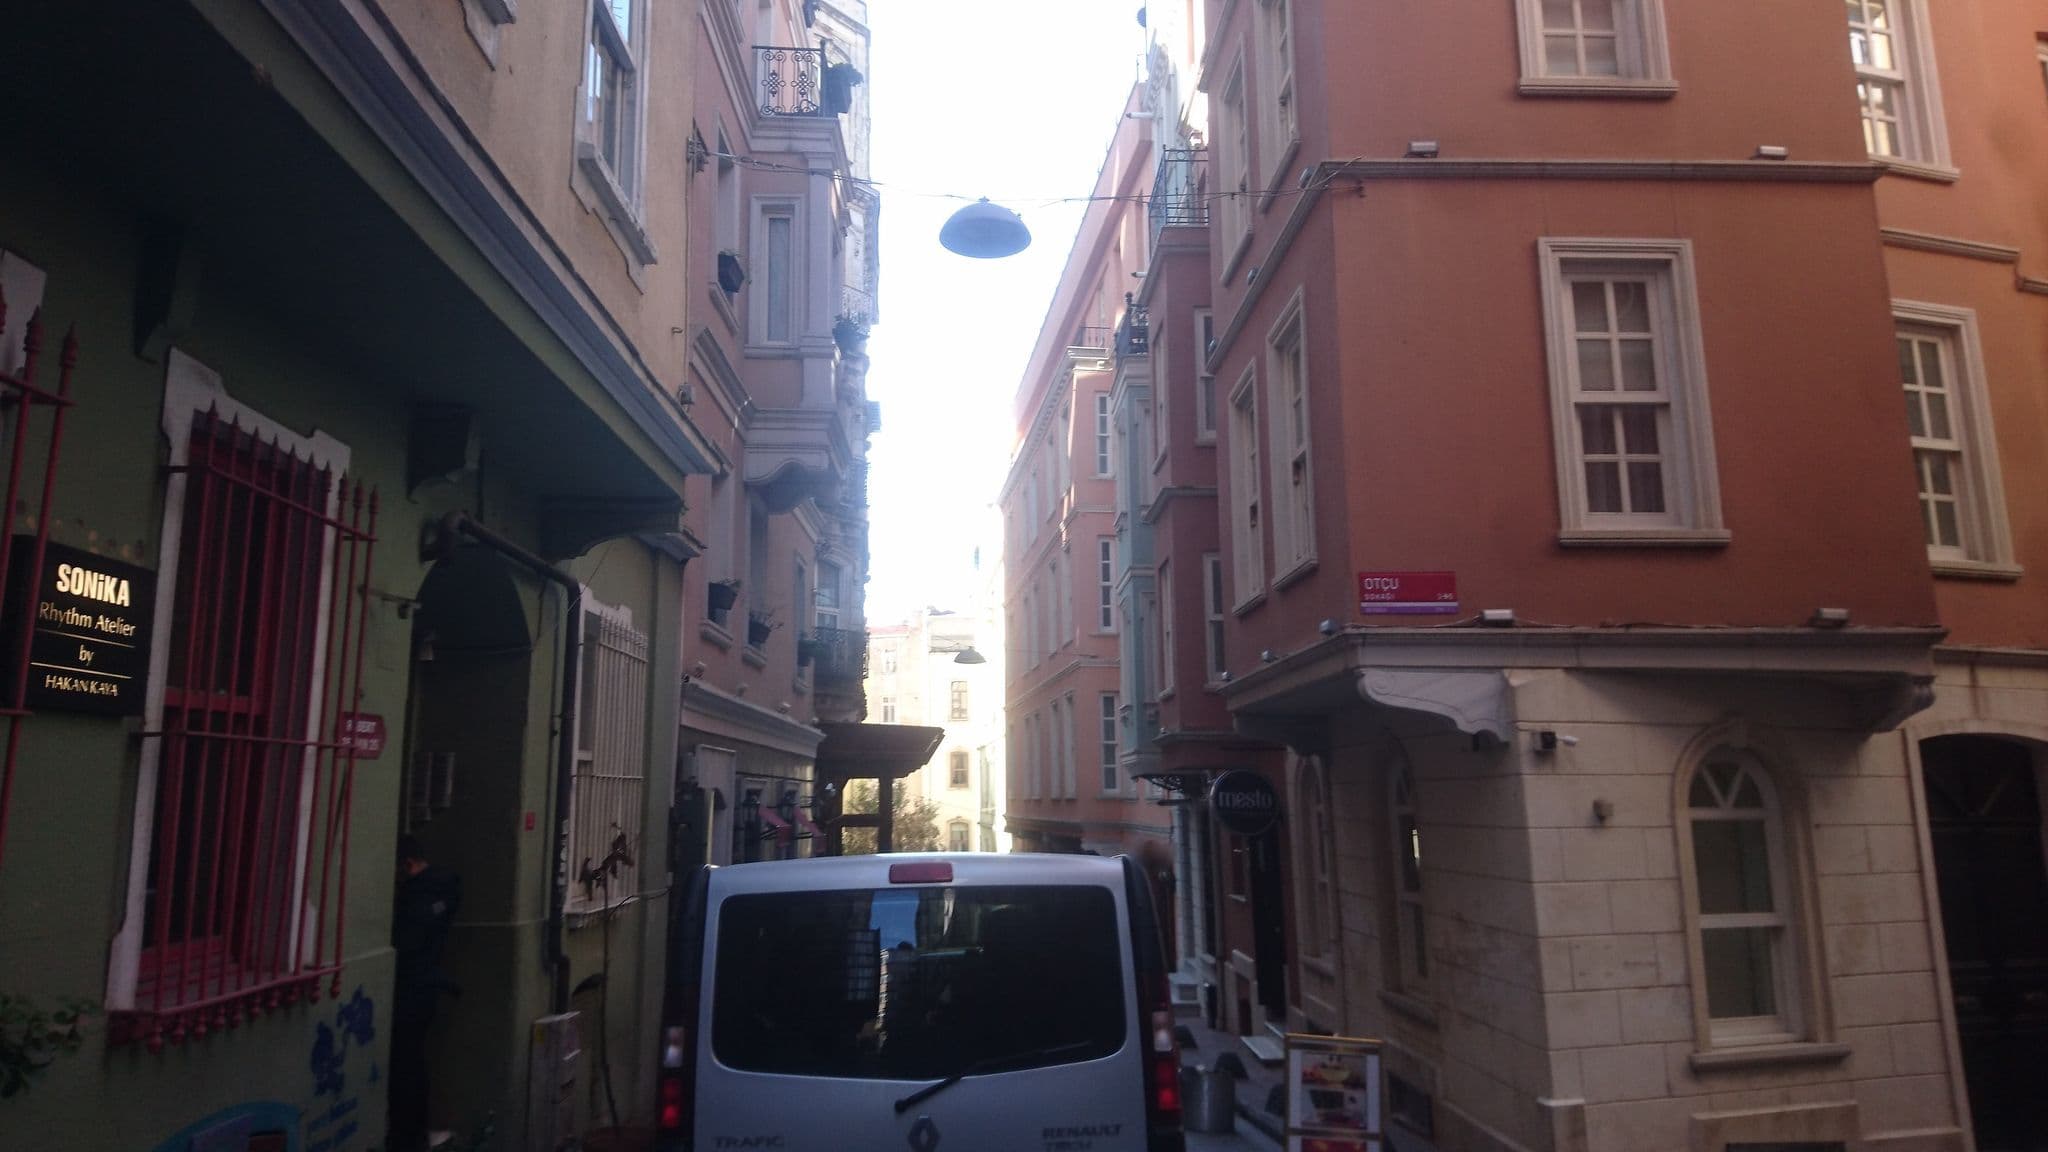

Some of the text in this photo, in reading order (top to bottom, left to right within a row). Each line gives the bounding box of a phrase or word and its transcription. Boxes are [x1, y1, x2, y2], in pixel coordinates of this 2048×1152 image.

[1363, 577, 1400, 591] OTÇU
[38, 601, 137, 637] Rhythm Atelier
[78, 644, 95, 667] by
[44, 674, 119, 697] HAKAN KAYA
[1218, 788, 1273, 809] mesto
[1041, 1124, 1122, 1137] RENAULT
[711, 1135, 786, 1149] TRAFIC
